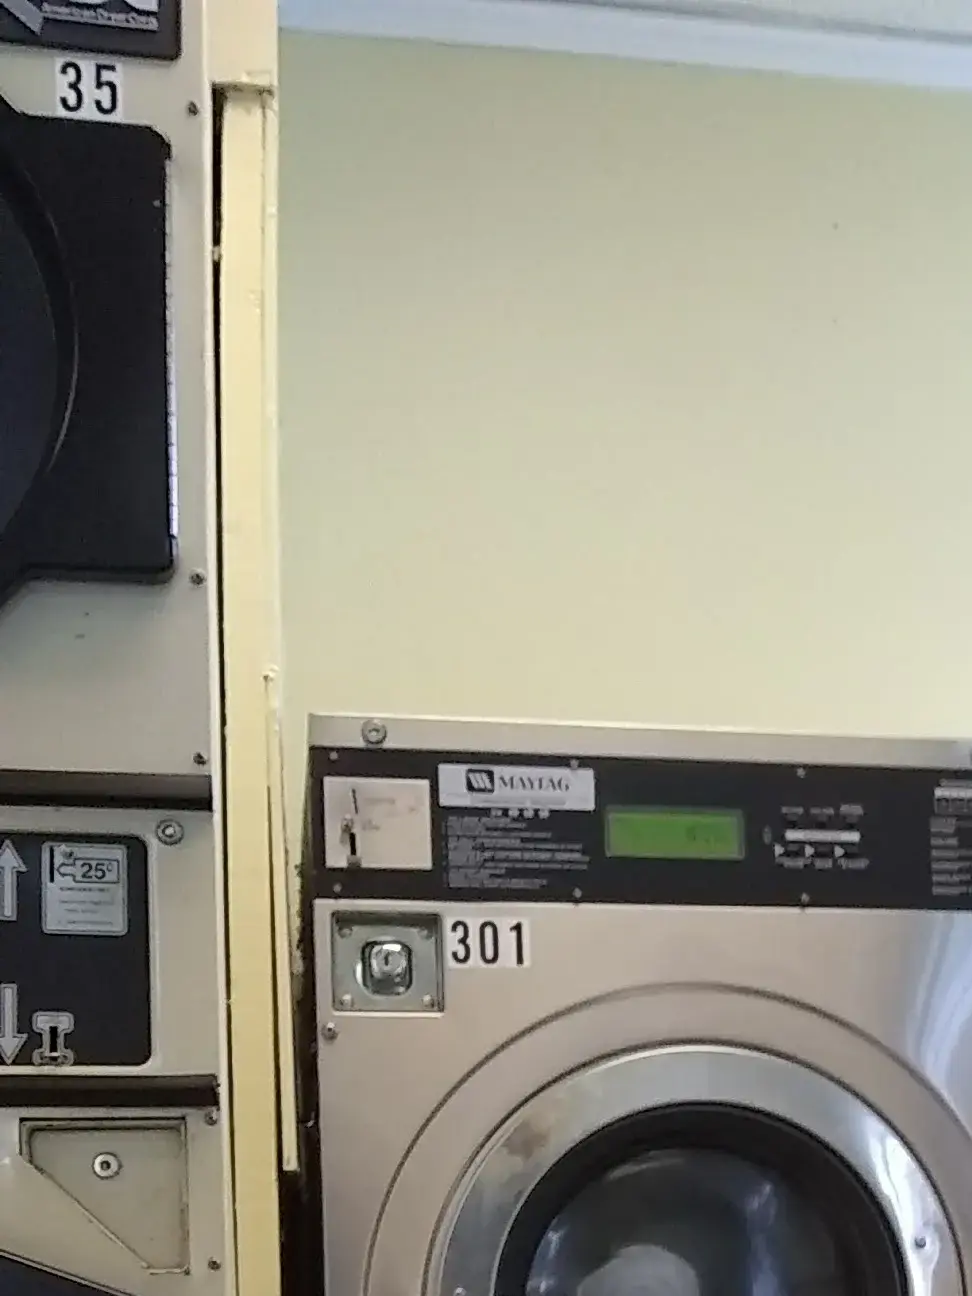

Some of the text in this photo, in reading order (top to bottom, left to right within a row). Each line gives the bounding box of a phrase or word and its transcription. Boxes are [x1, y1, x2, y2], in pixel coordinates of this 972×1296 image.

[59, 61, 118, 115] 35
[498, 775, 570, 793] MAYTAG
[450, 920, 525, 966] 301
